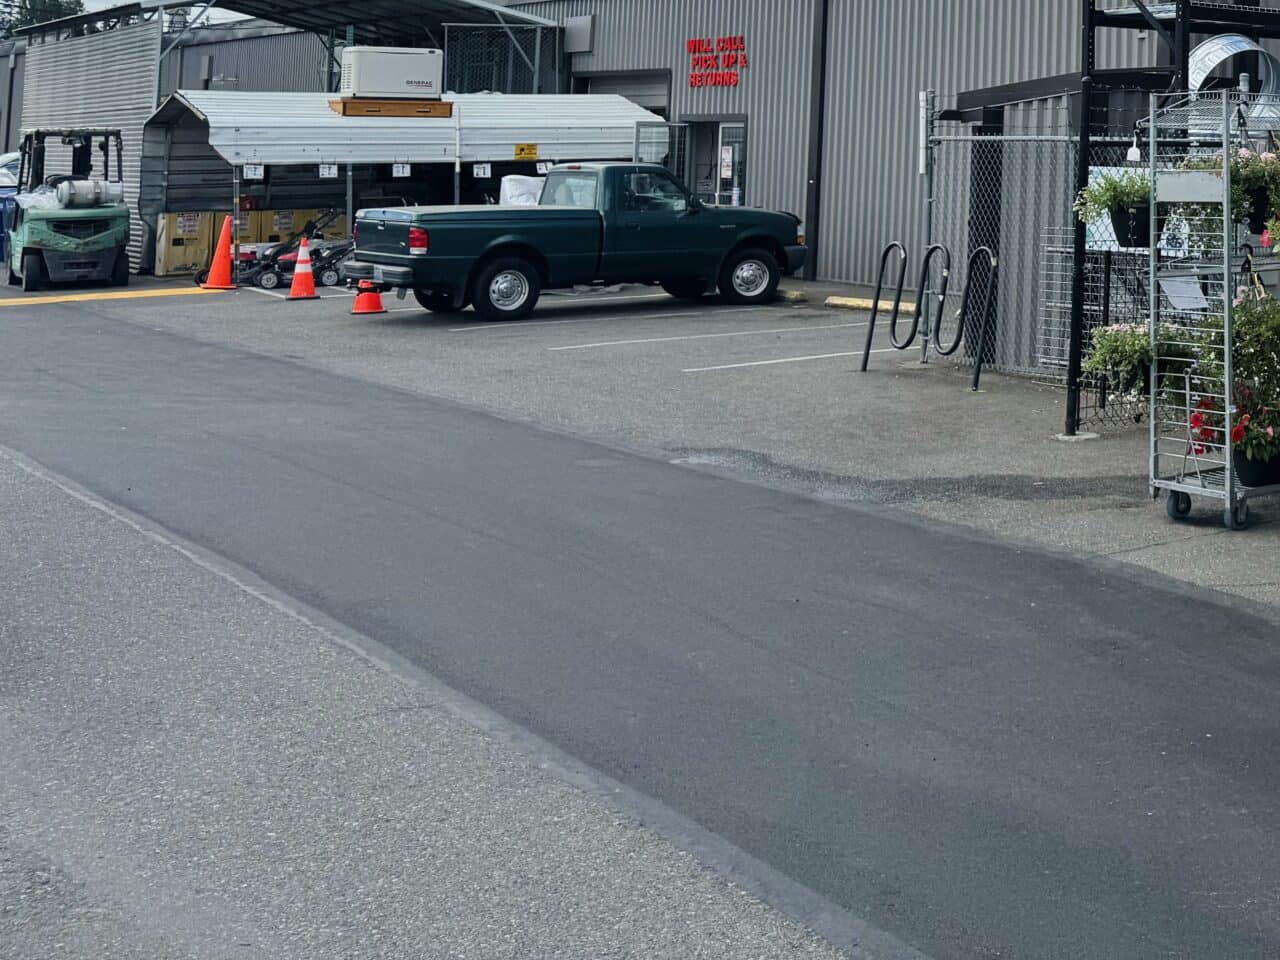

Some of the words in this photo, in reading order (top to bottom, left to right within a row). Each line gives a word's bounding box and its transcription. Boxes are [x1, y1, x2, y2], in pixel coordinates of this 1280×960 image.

[687, 38, 713, 53] WILL
[716, 36, 744, 51] CALL
[692, 54, 718, 69] PICK
[722, 53, 737, 68] UP
[739, 52, 747, 68] &
[689, 71, 738, 87] RETURNS
